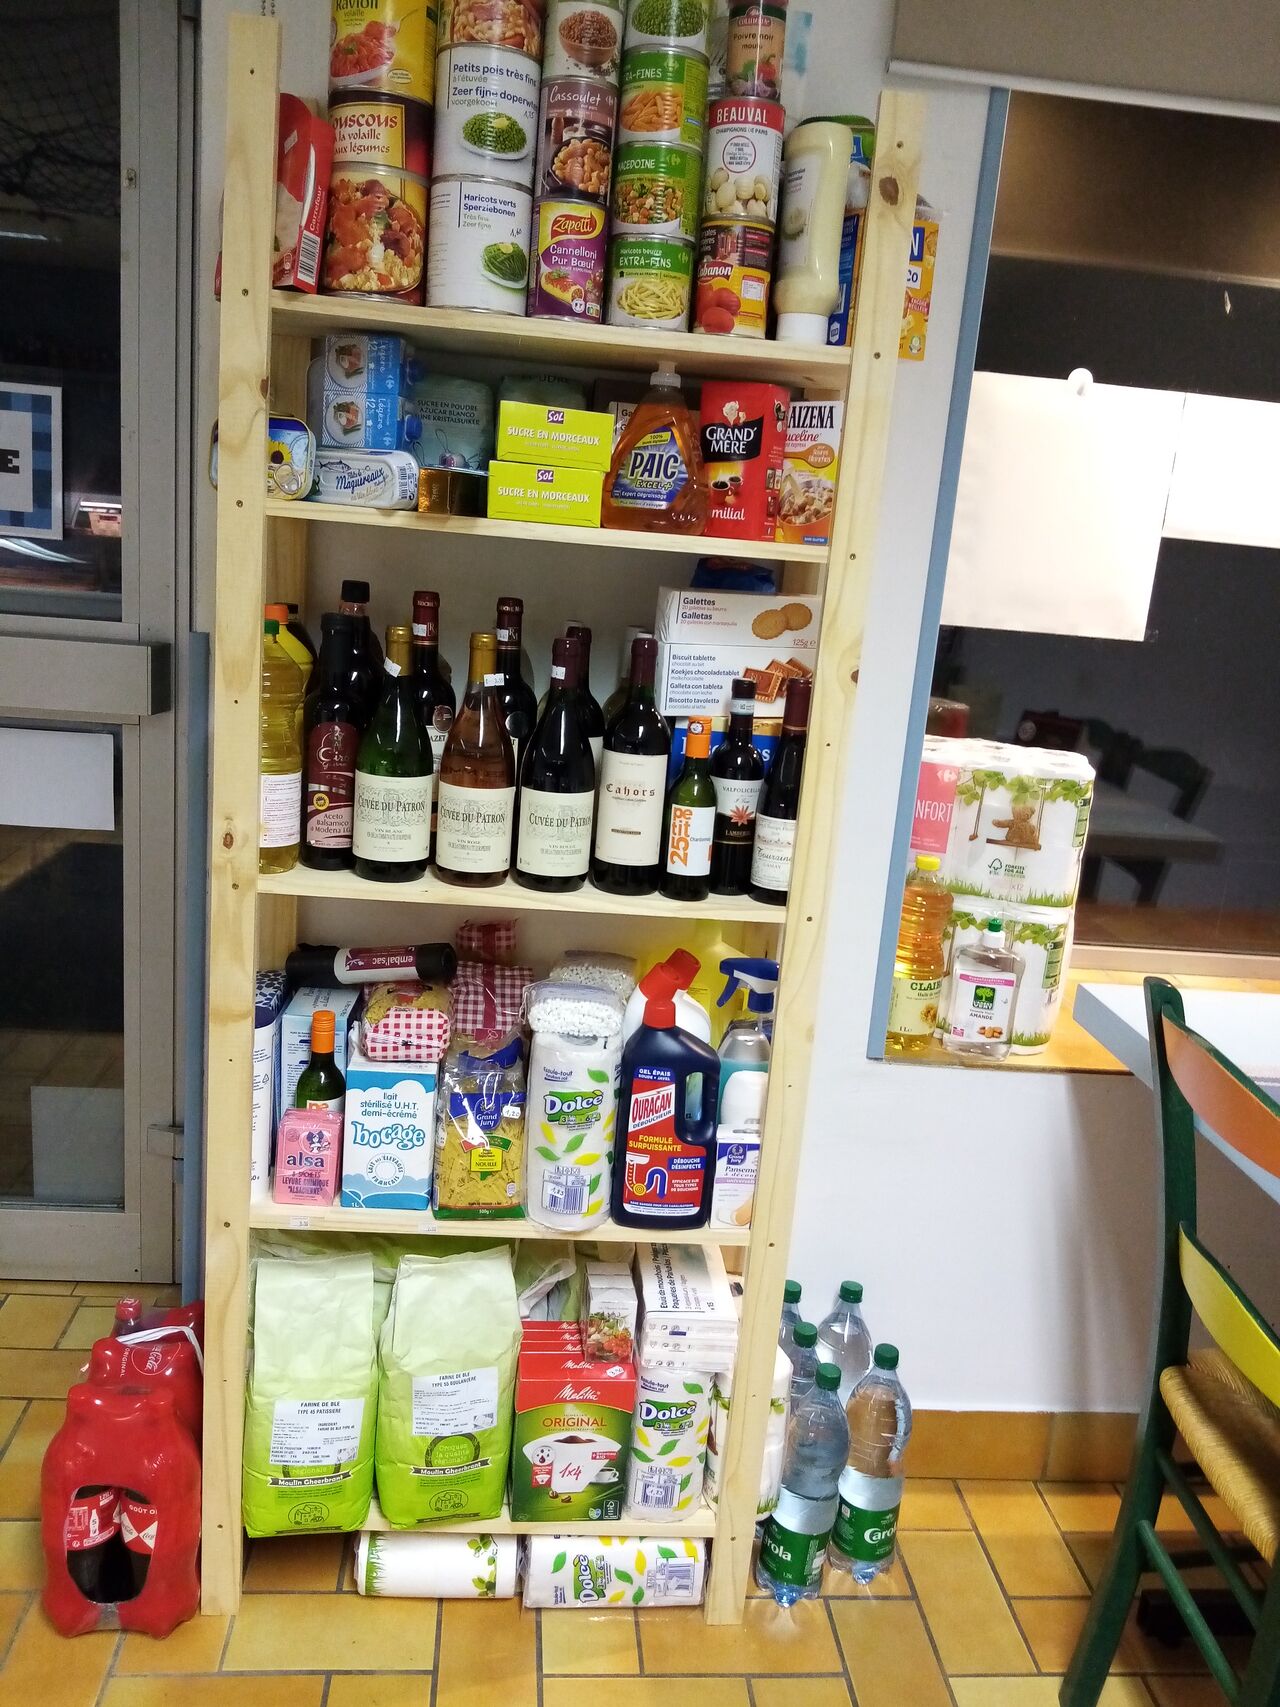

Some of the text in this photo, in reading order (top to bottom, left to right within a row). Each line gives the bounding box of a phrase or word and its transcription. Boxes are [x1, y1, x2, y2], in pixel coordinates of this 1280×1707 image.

[453, 63, 480, 72] Petits
[483, 65, 504, 75] pois
[506, 68, 523, 80] très
[453, 86, 498, 98] Zeer fijne
[551, 86, 600, 104] Cassoulet
[717, 107, 767, 124] BEAUVAL
[348, 129, 381, 140] volaille
[350, 142, 389, 154] légumes
[464, 194, 516, 208] Haricots verts
[310, 186, 322, 231] Carrefour
[464, 204, 515, 217] Sperziebonen
[553, 215, 593, 233] Zapetti
[550, 244, 596, 259] Cannelloni
[552, 256, 568, 265] Pur
[571, 259, 594, 269] Bœuf
[620, 257, 671, 268] EXTRA-FINS
[418, 400, 439, 408] SUCRE
[451, 403, 478, 411] POUDRE
[449, 410, 475, 418] BLANCO
[507, 426, 600, 446] SUCRE EN MORCEAUX
[629, 451, 680, 480] PAIC
[498, 487, 589, 503] SUCRE EN MORCEAUX
[683, 597, 715, 605] Galettes
[682, 612, 712, 620] Galletas
[606, 783, 655, 797] Cahors
[381, 803, 394, 811] DU
[396, 800, 425, 811] PATRON
[462, 813, 473, 822] DU
[476, 812, 505, 823] PATRON
[529, 813, 554, 827] CUVÉE
[557, 818, 568, 828] DU
[373, 956, 413, 965] embal'sac
[361, 1101, 419, 1110] stérilisé U.H.T.
[632, 1092, 672, 1123] OURAGAN
[362, 1109, 417, 1119] demi-écrémé
[633, 1110, 671, 1128] DÉBOUCHEUR
[351, 1121, 425, 1150] bocage
[639, 1135, 672, 1143] FORMULE
[629, 1141, 682, 1151] SURPUISSANTE
[287, 1152, 324, 1168] alsa
[283, 1177, 301, 1185] LEVURE
[561, 1360, 594, 1369] Melitta
[554, 1383, 598, 1400] Melitta
[542, 1417, 607, 1427] ORIGINAL
[560, 1462, 582, 1480] 1x4
[129, 1505, 147, 1514] GOÛT
